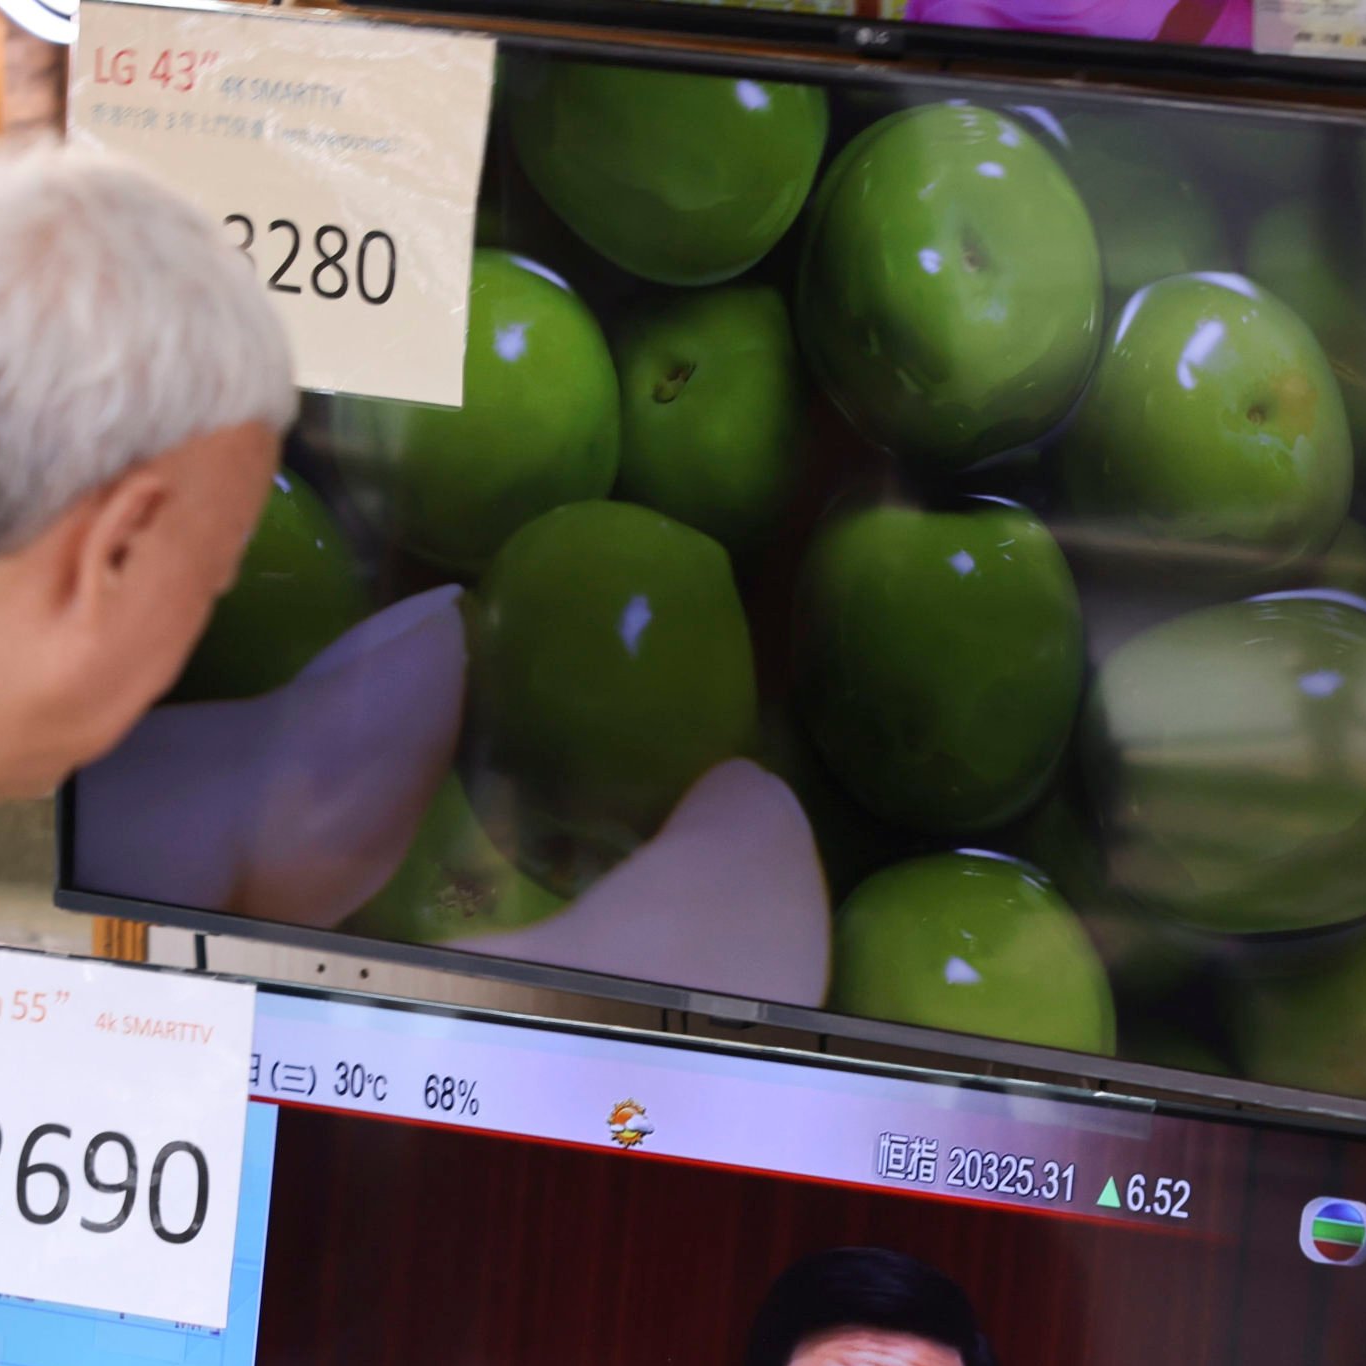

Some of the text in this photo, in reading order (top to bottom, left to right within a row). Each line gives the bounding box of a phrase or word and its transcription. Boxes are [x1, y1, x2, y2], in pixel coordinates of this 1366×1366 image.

[92, 46, 137, 87] LG
[122, 1014, 215, 1045] SMARTTV
[423, 1073, 480, 1117] 68%
[877, 1131, 1192, 1219] 恒指 20325.31 6.52
